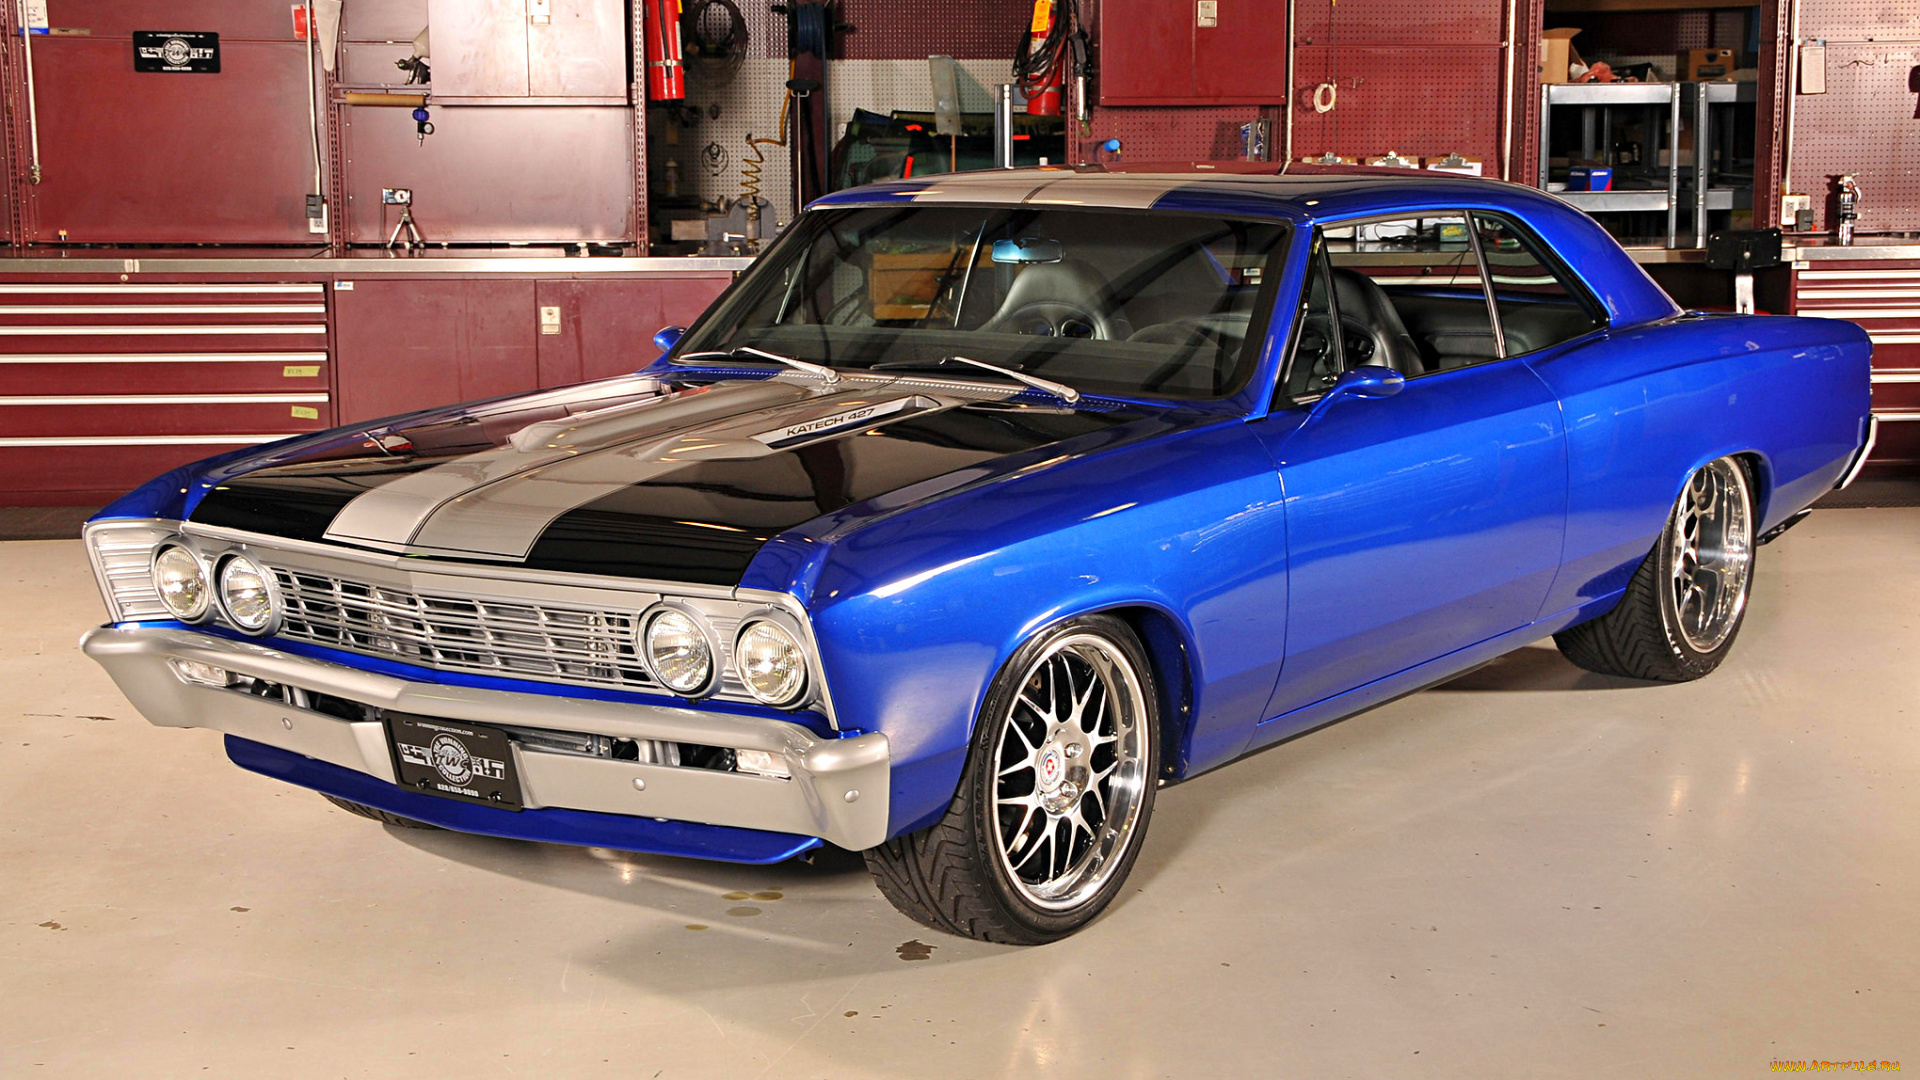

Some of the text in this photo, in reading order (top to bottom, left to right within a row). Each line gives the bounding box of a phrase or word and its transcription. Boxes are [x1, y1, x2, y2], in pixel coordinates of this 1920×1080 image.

[787, 408, 875, 436] KATECH 427
[436, 754, 469, 769] TWC
[438, 764, 471, 783] COLLECTION
